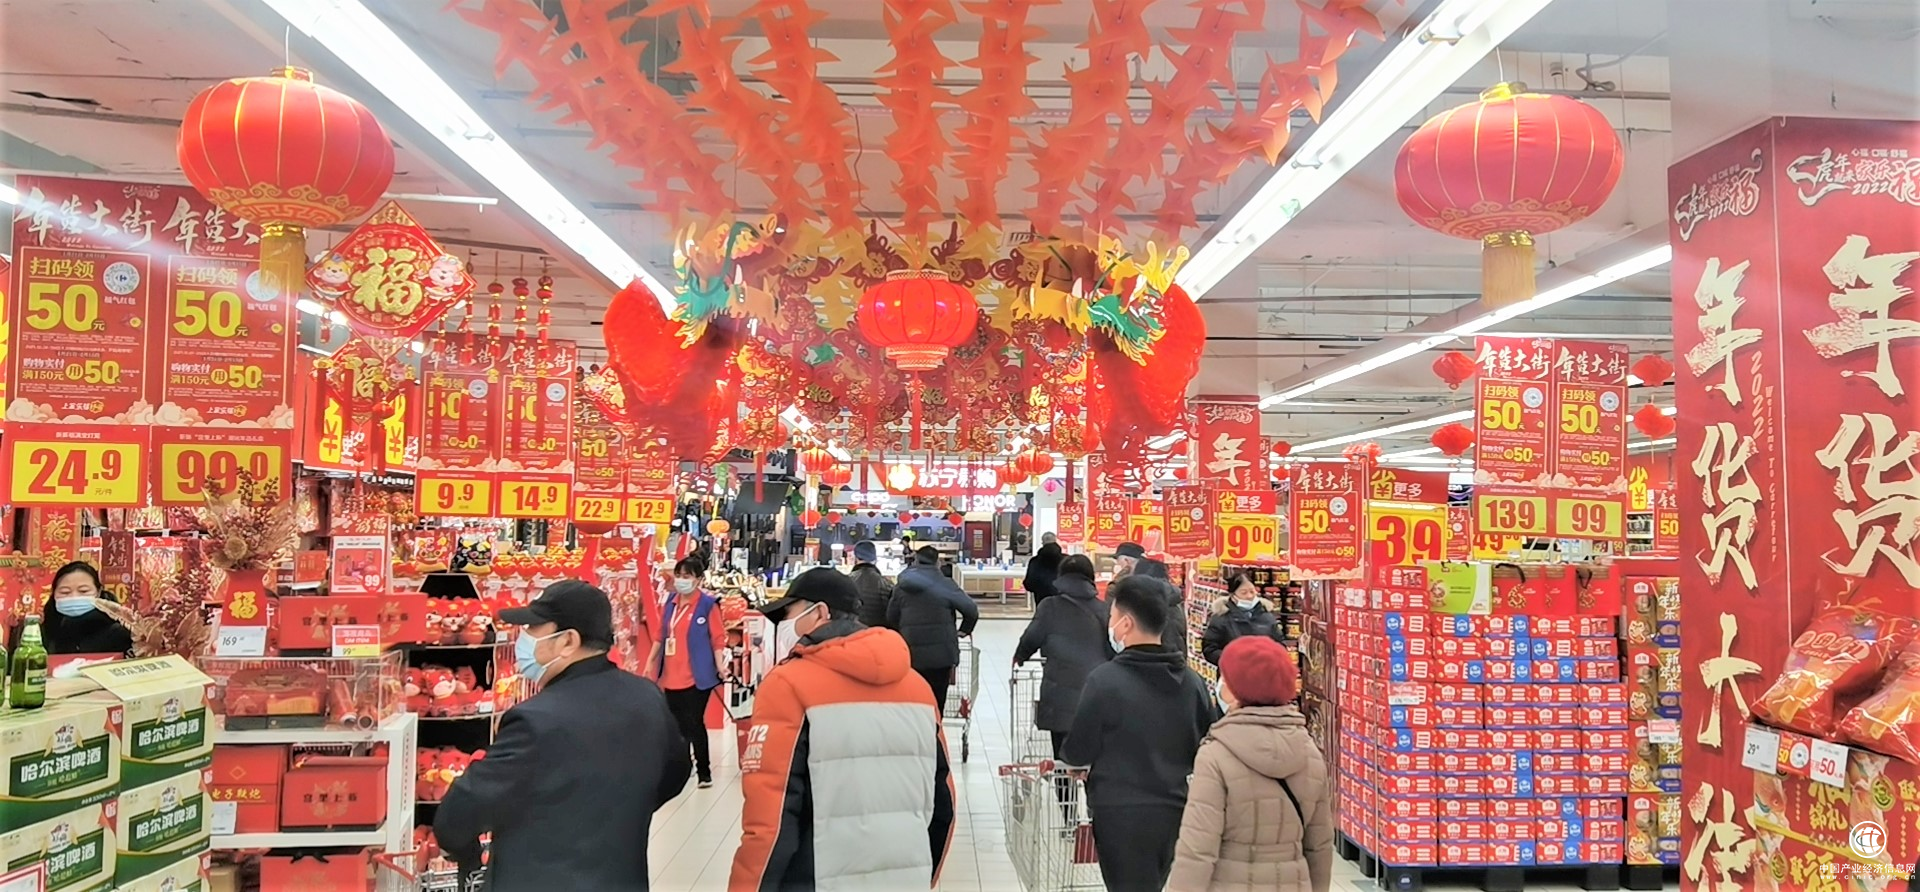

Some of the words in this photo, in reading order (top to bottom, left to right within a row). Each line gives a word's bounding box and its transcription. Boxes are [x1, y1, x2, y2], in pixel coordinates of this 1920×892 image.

[1851, 181, 1889, 195] 2022
[14, 187, 156, 250] 年货大街
[30, 257, 94, 278] 扫码领
[176, 265, 238, 286] 扫码领
[351, 246, 423, 316] 福
[26, 283, 98, 332] 50
[93, 320, 105, 331] 元
[173, 290, 242, 337] 50
[237, 327, 248, 337] 元
[420, 338, 496, 372] 年货街
[1475, 341, 1551, 380] 年货大街
[1554, 346, 1627, 385] 年货大街
[22, 369, 65, 381] 满150元
[84, 360, 119, 384] 50
[170, 374, 210, 386] 满150元
[228, 364, 262, 389] 50
[1484, 384, 1519, 398] 扫码领
[1562, 388, 1596, 402] 扫码领
[1751, 351, 1764, 439] 2022
[1483, 400, 1521, 431] 50
[1561, 404, 1598, 434] 50
[1765, 386, 1774, 451] Welcome
[581, 438, 607, 457] 50
[1205, 433, 1252, 486] 年
[1514, 447, 1533, 463] 50
[1591, 450, 1611, 466] 50
[28, 448, 121, 495] 24.9
[599, 467, 614, 476] 50
[918, 468, 997, 490] 苏宁易购
[1768, 458, 1775, 478] To
[1296, 467, 1354, 495] 年货大街
[437, 482, 474, 510] 9.9
[512, 485, 558, 511] 14.9
[581, 500, 614, 518] 22.9
[635, 501, 664, 519] 12.9
[1299, 509, 1330, 534] 50
[1486, 499, 1536, 531] 139
[1571, 503, 1606, 533] 99
[1059, 518, 1073, 529] 50
[1099, 518, 1114, 530] 50
[1170, 517, 1192, 533] 50
[1659, 519, 1679, 536] 50
[1769, 483, 1778, 562] Carrefour
[1343, 546, 1355, 558] 50
[1377, 515, 1442, 568] 39
[364, 574, 380, 587] 99
[229, 590, 258, 619] 福
[222, 636, 238, 646] 169
[108, 660, 173, 678] 哈尔滨啤酒
[138, 718, 200, 748] 哈尔滨啤酒
[20, 746, 102, 783] 哈尔滨啤酒
[1778, 748, 1789, 764] 50
[1820, 757, 1836, 776] 50
[211, 788, 262, 800] 电子鞭炮
[136, 803, 198, 840] 哈尔滨啤酒
[46, 842, 96, 875] 滨啤酒
